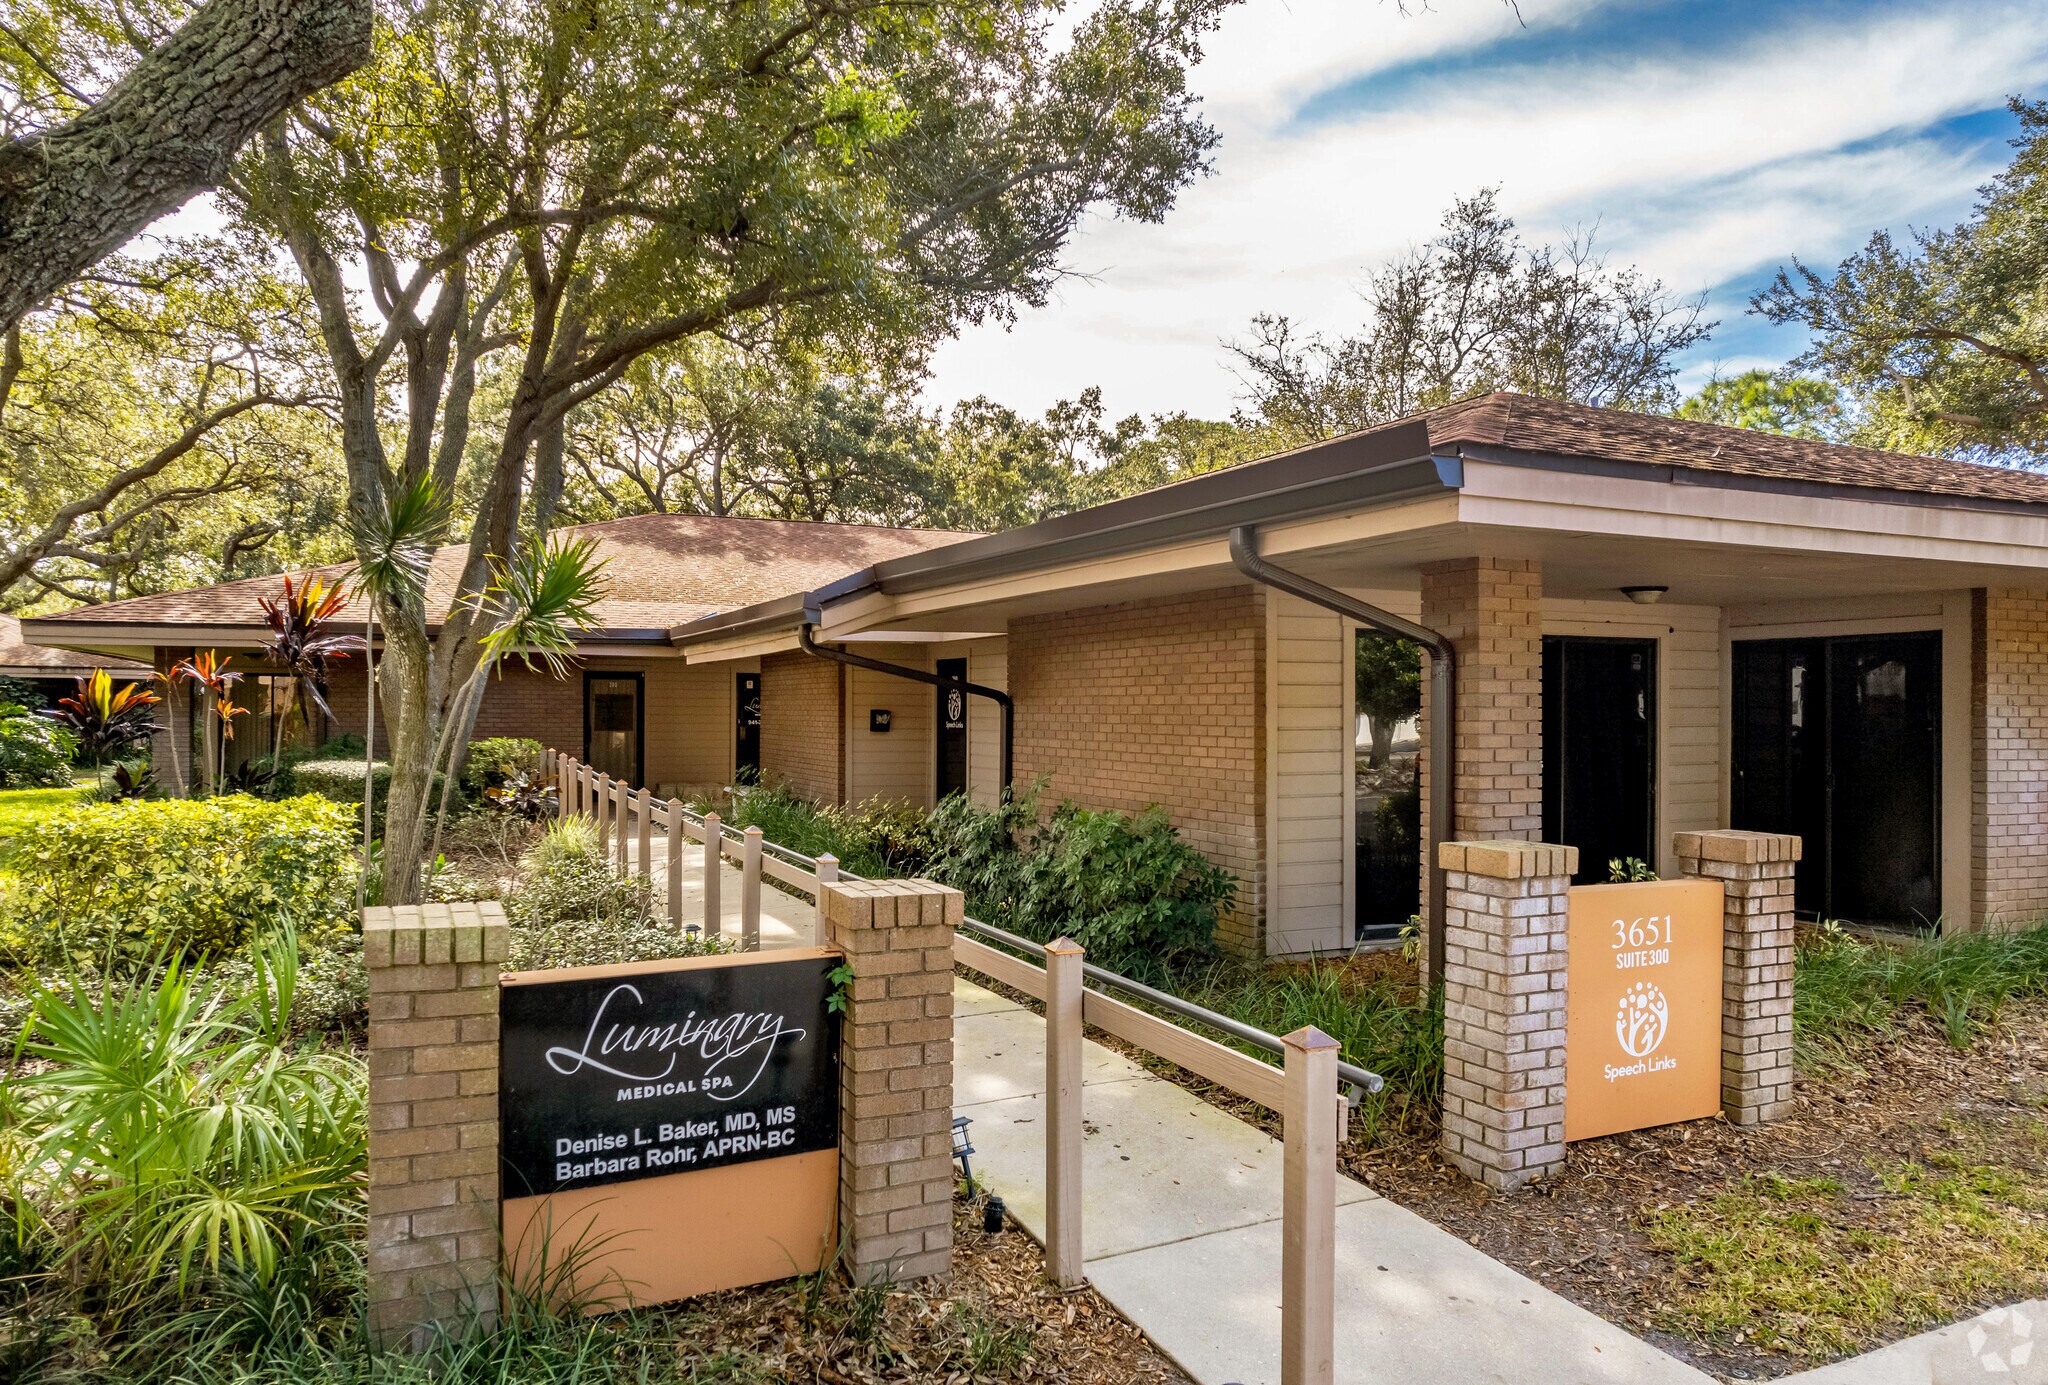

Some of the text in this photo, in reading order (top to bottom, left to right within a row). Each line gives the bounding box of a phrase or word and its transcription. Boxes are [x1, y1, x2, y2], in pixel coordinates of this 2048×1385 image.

[1611, 915, 1673, 949] 3651
[1616, 948, 1669, 969] SUITE 300
[545, 984, 806, 1101] Luminary
[1604, 1056, 1677, 1082] Speech Links
[617, 1075, 733, 1102] MEDICAL SPA
[556, 1106, 796, 1157] Denise L. Baker, MD, MS
[556, 1128, 795, 1181] Barbara Rohr, APRN-BC
